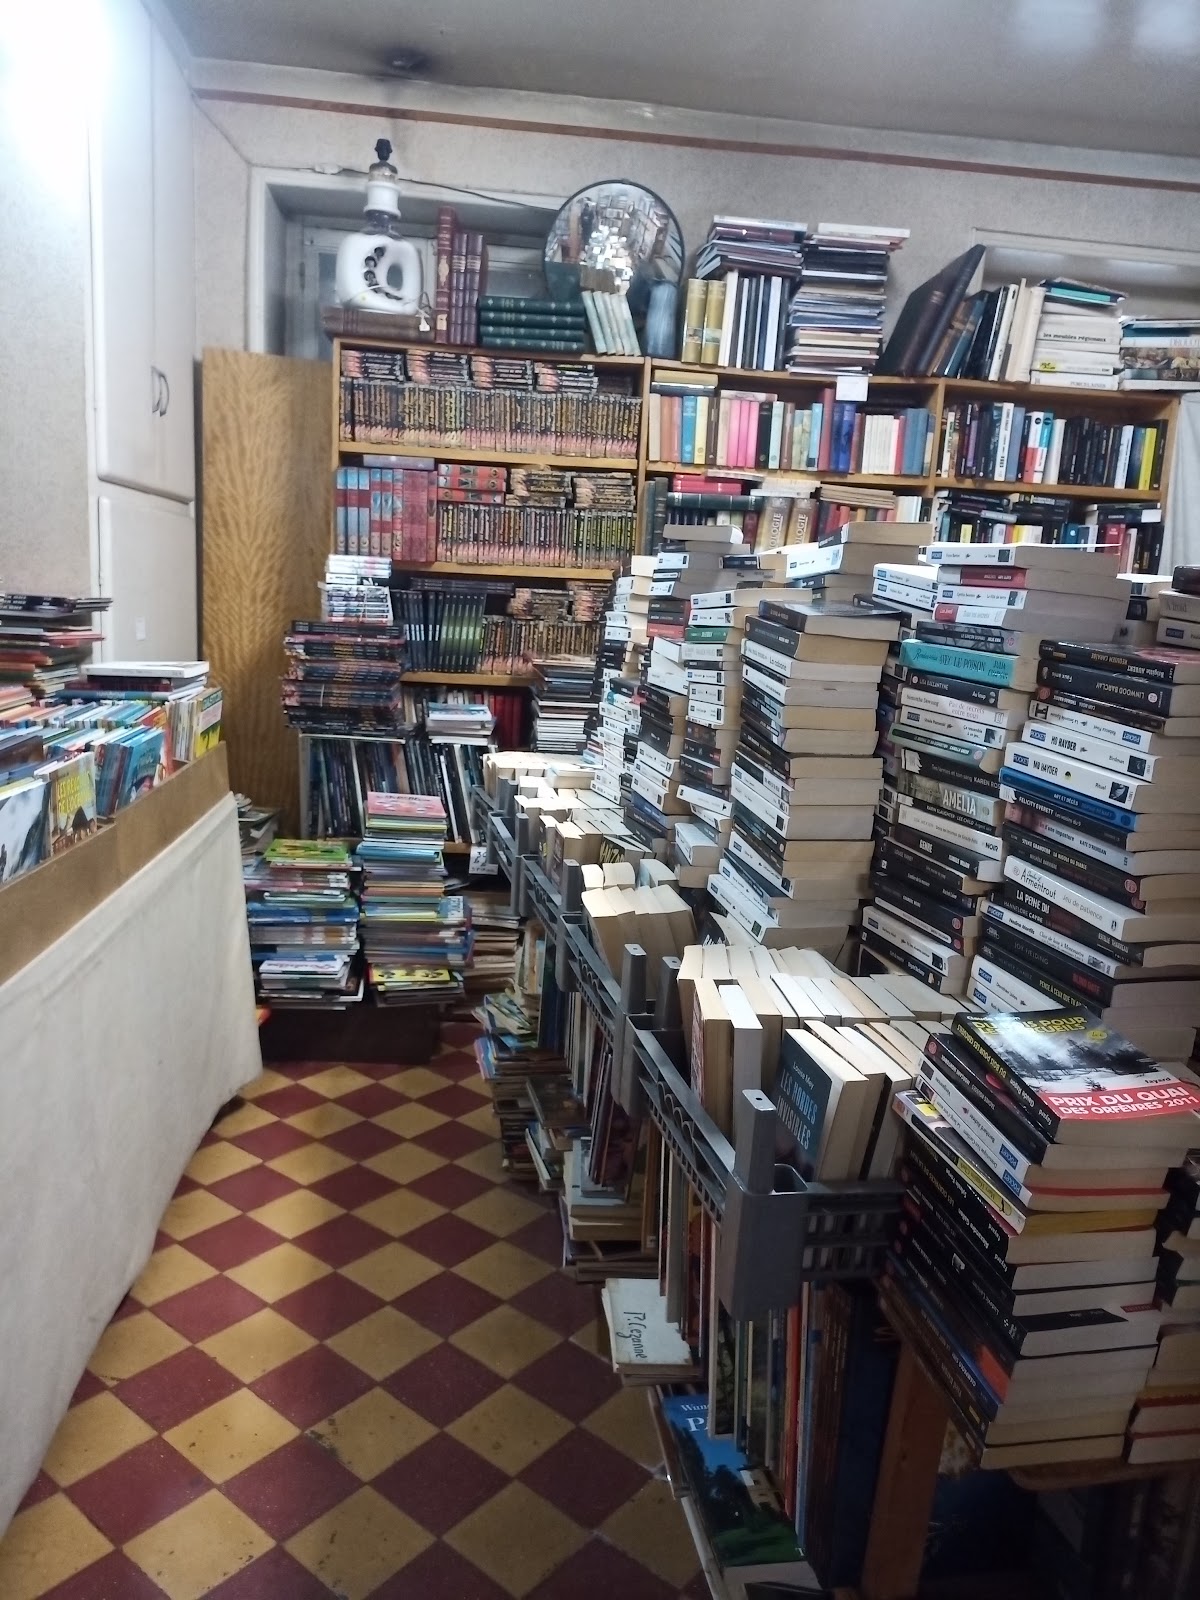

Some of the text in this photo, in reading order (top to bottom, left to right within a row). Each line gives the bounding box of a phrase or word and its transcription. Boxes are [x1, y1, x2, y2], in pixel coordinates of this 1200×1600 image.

[1094, 681, 1145, 699] LINWOOD BARCLAY
[973, 776, 990, 785] KAREN
[990, 781, 1001, 789] ROS
[940, 789, 980, 815] AMELIA
[984, 842, 999, 852] NOIR
[1018, 868, 1061, 899] Armentrout
[1014, 889, 1051, 915] LA PEINE DU
[1070, 898, 1081, 908] de
[1078, 903, 1104, 921] patience
[1039, 1016, 1087, 1026] POUR
[780, 1068, 792, 1093] LES
[1007, 1077, 1036, 1108] Claude Ragon
[1052, 1087, 1188, 1108] PRIX DU QUAI
[1036, 1107, 1054, 1126] fayard
[1059, 1096, 1199, 1115] DES ORFÈVRES 2011
[777, 1094, 811, 1150] INVISIBLES
[997, 1144, 1020, 1168] POCKET
[1000, 1170, 1023, 1194] POCKET
[984, 1221, 1003, 1242] fayard
[990, 1252, 1010, 1272] fayard
